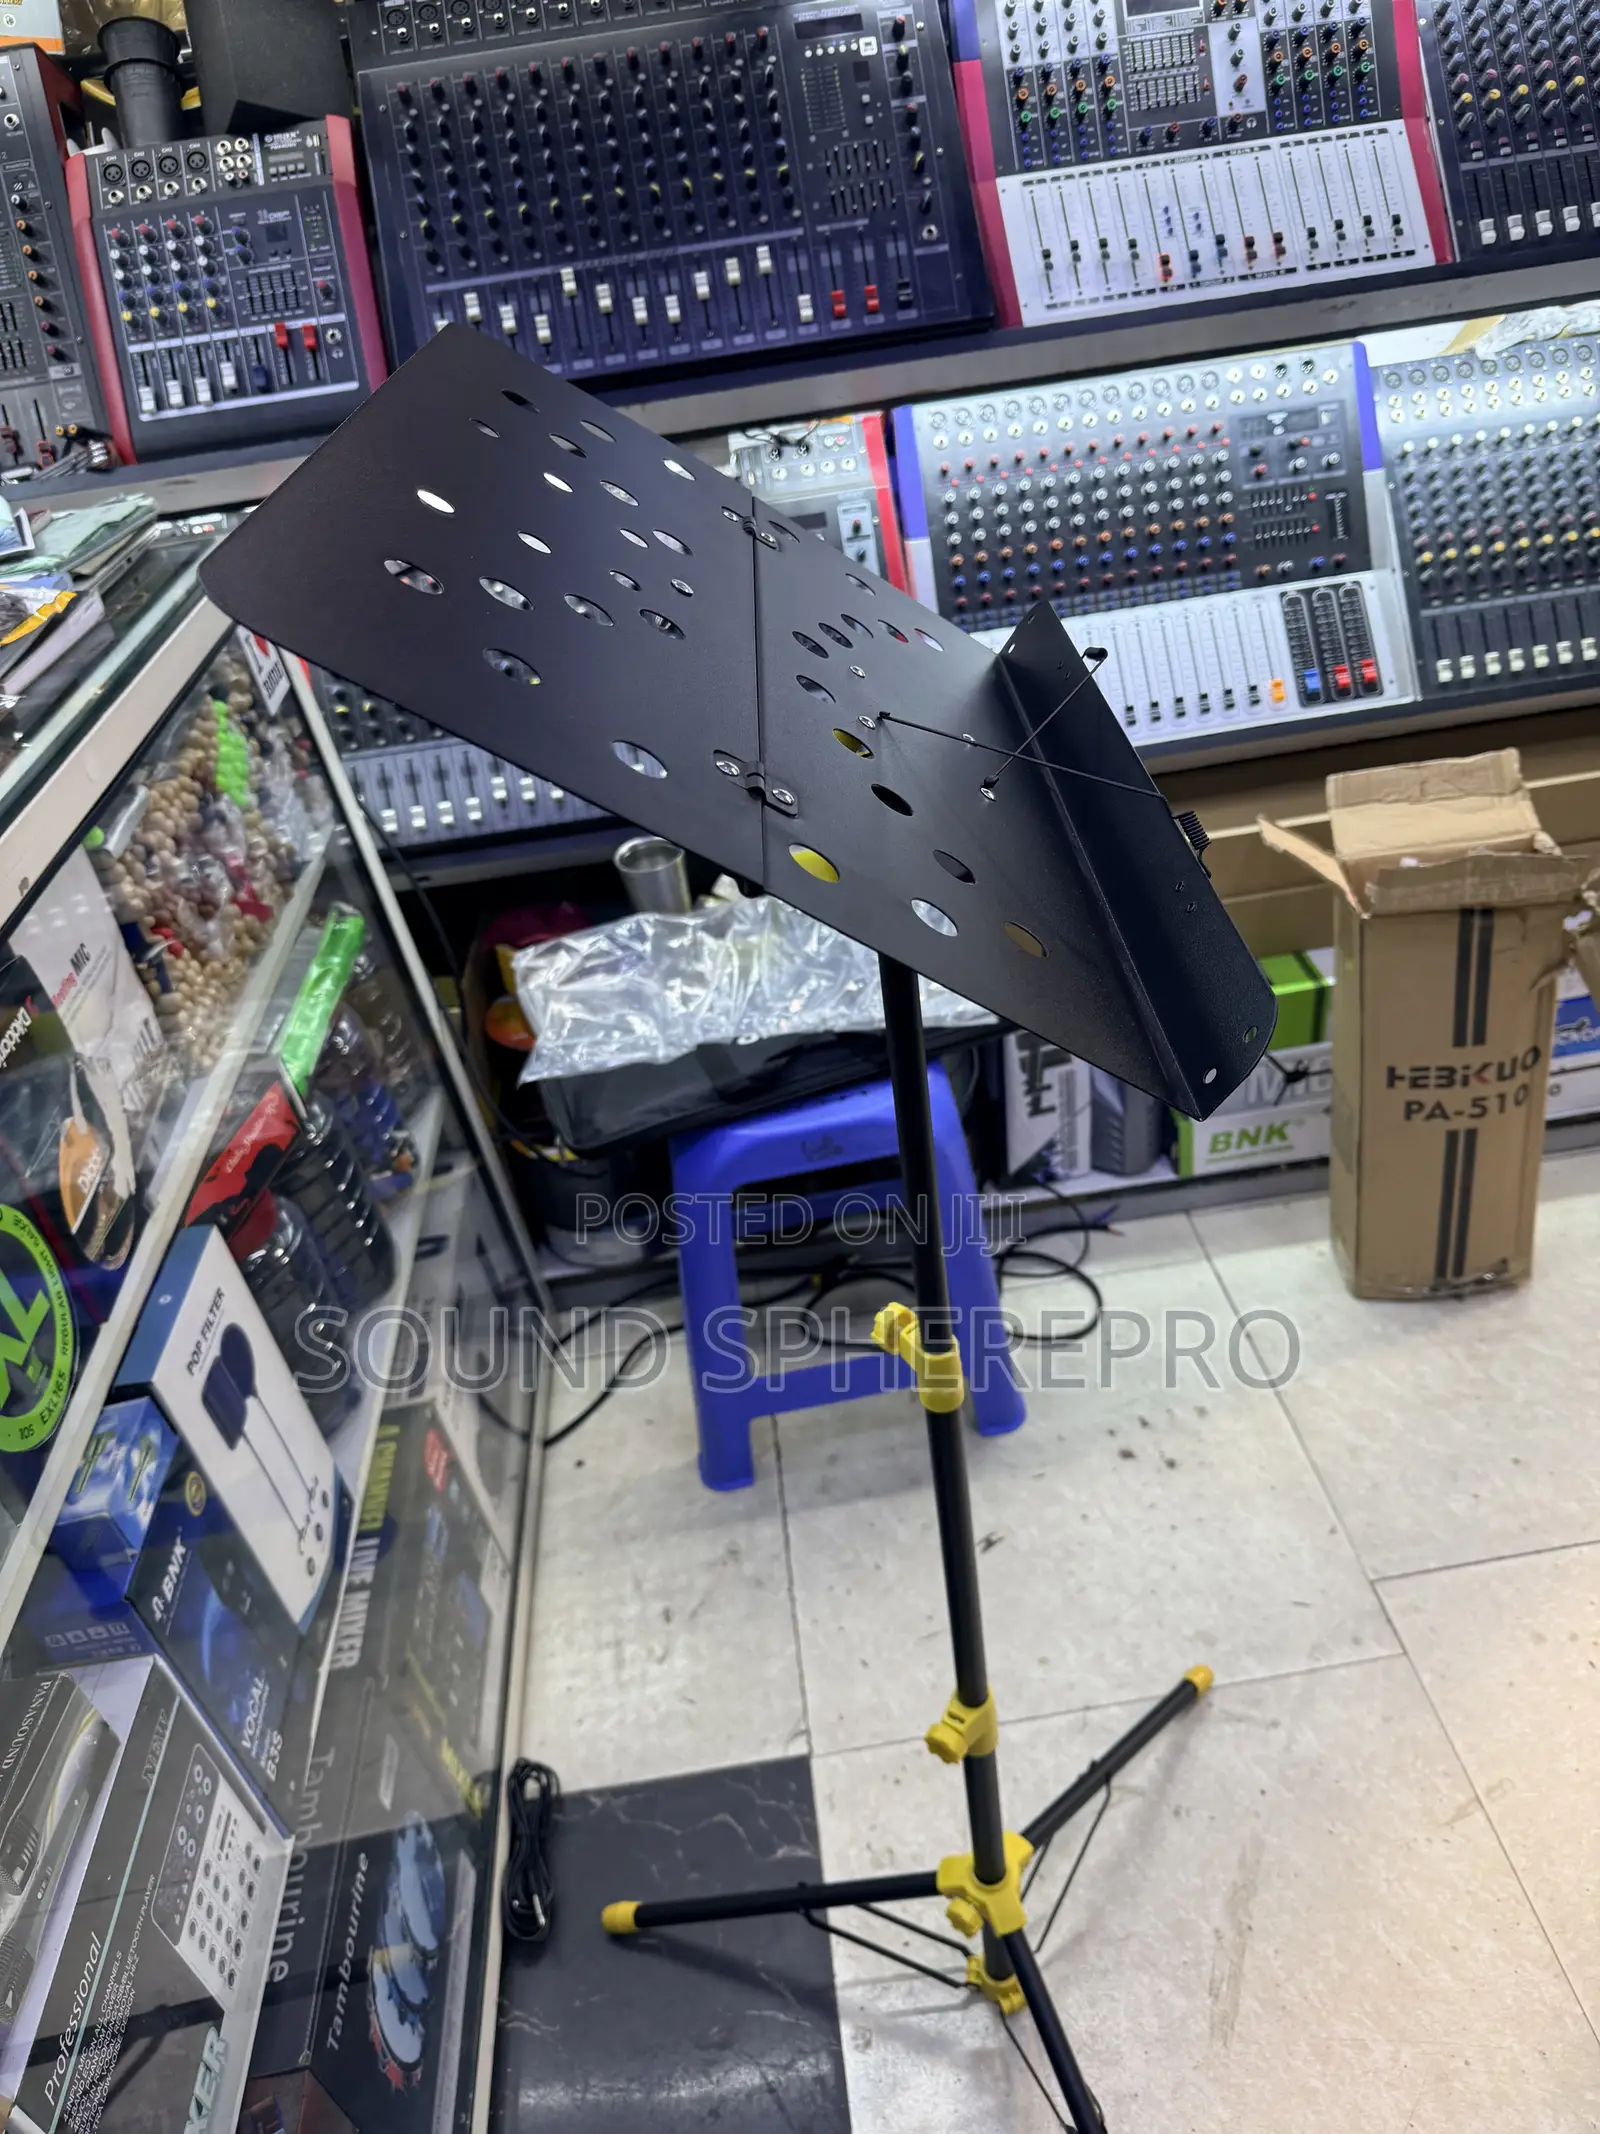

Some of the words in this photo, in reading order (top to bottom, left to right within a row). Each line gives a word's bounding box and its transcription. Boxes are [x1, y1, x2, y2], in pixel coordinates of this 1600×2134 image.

[70, 942, 91, 977] MIC
[1209, 1119, 1291, 1154] BNK
[1404, 1084, 1529, 1121] PA-510
[186, 1341, 205, 1377] POP
[200, 1286, 226, 1344] FILTER
[162, 1534, 188, 1606] BNK
[330, 1590, 371, 1671] MIXER
[1, 1680, 53, 1770] PANASOUND
[241, 1677, 265, 1749] VOCAL
[268, 1746, 335, 1985] Tambourine
[326, 1852, 370, 2051] Tambourine
[45, 1931, 101, 2106] Professional
[68, 2080, 85, 2128] 2-BAND
[82, 2059, 91, 2079] EQ
[88, 2038, 97, 2058] ON
[94, 2016, 104, 2038] ALL
[101, 1950, 122, 2013] CHANNELS
[85, 2028, 106, 2090] PHANTOM
[103, 1982, 119, 2028] POWER
[101, 2033, 123, 2104] LOW-NOISE
[120, 1987, 136, 2034] DESIGN
[102, 2037, 117, 2076] VOCAL
[113, 1980, 134, 2035] REMOVAL
[63, 2071, 81, 2122] 4-INPUT
[78, 2046, 89, 2071] MIC
